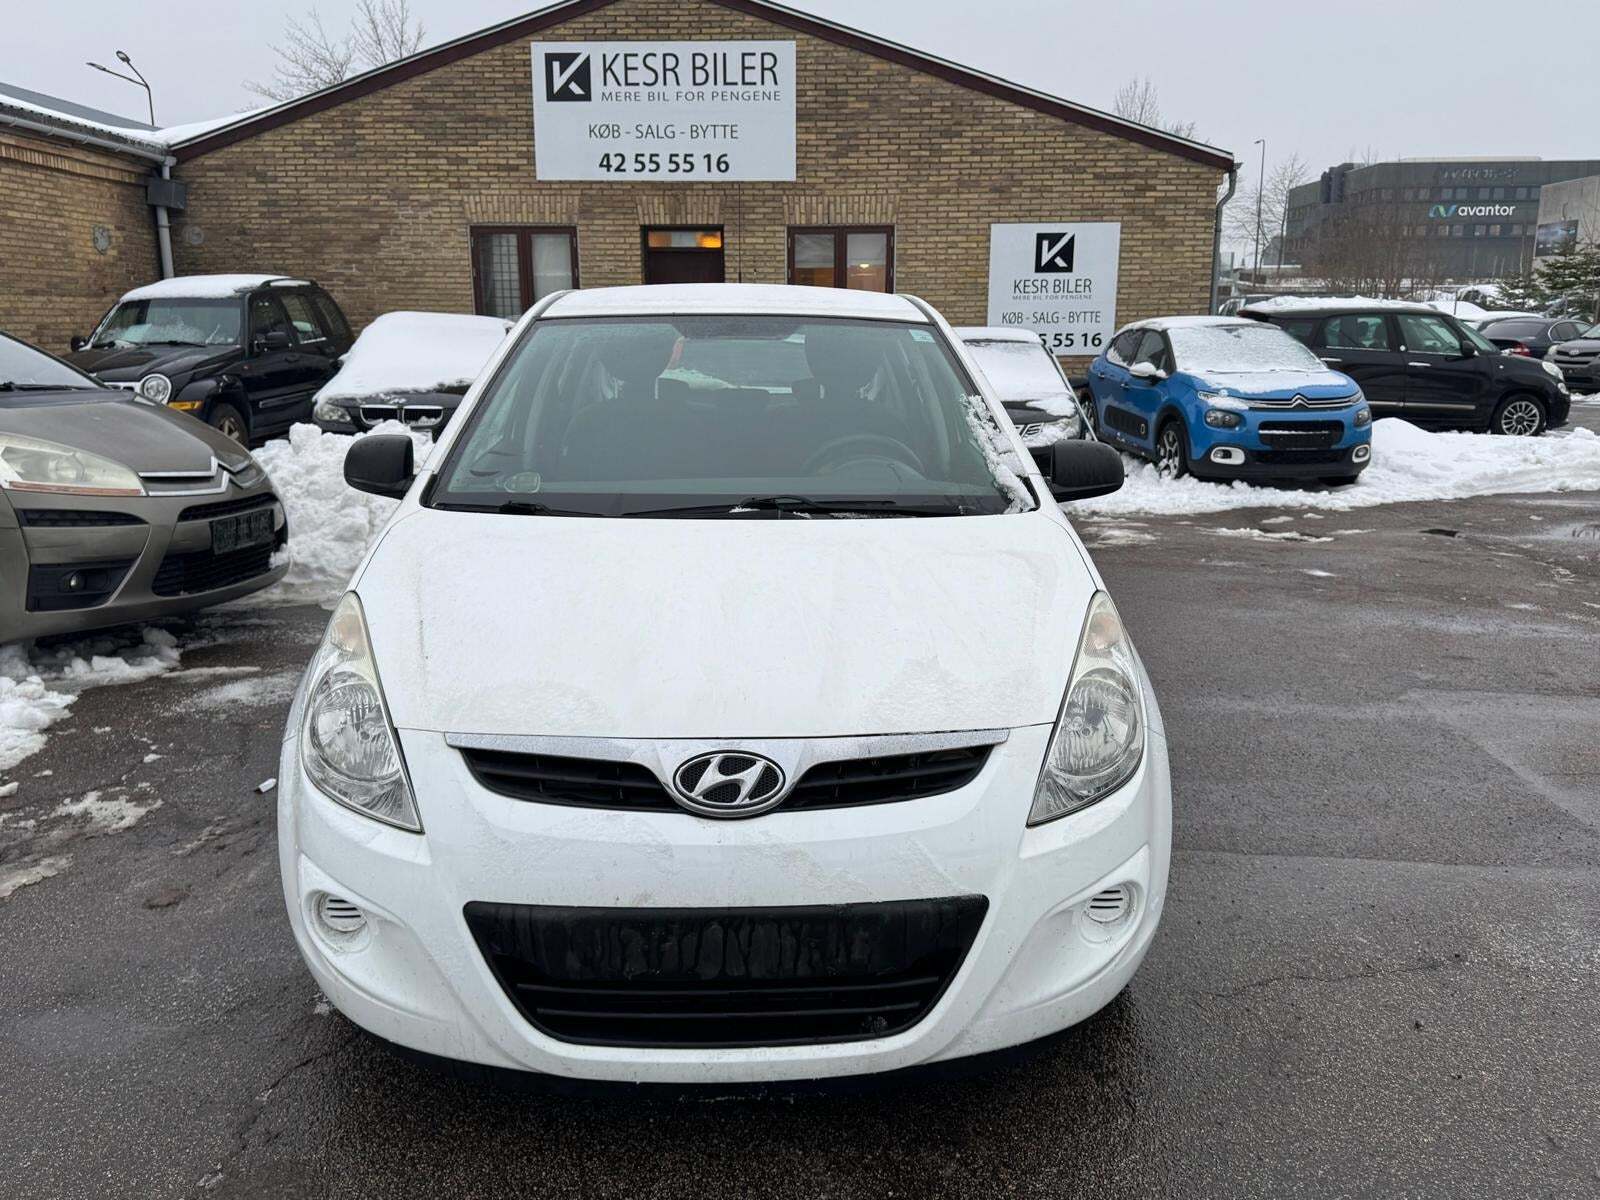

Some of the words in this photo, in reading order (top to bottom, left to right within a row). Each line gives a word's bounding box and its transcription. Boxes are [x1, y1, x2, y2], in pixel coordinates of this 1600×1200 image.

[602, 53, 681, 87] KESR
[691, 52, 779, 87] BILER
[601, 91, 641, 102] MERE
[647, 91, 670, 102] BIL
[676, 91, 705, 102] FOR
[711, 91, 781, 102] PENGENE
[588, 123, 621, 140] KØB
[635, 123, 676, 140] SALG
[690, 123, 739, 140] BYTTE
[598, 152, 627, 173] 42
[633, 152, 661, 173] 55
[667, 152, 696, 173] 55
[702, 152, 731, 173] 16
[1457, 204, 1516, 217] avantor
[1013, 278, 1049, 294] KESR
[1052, 278, 1092, 294] BILER
[1001, 311, 1024, 325] KØB
[1032, 311, 1060, 325] SALG
[1068, 311, 1101, 324] BYTTE
[1052, 333, 1074, 348] 55
[1080, 332, 1103, 348] 16
